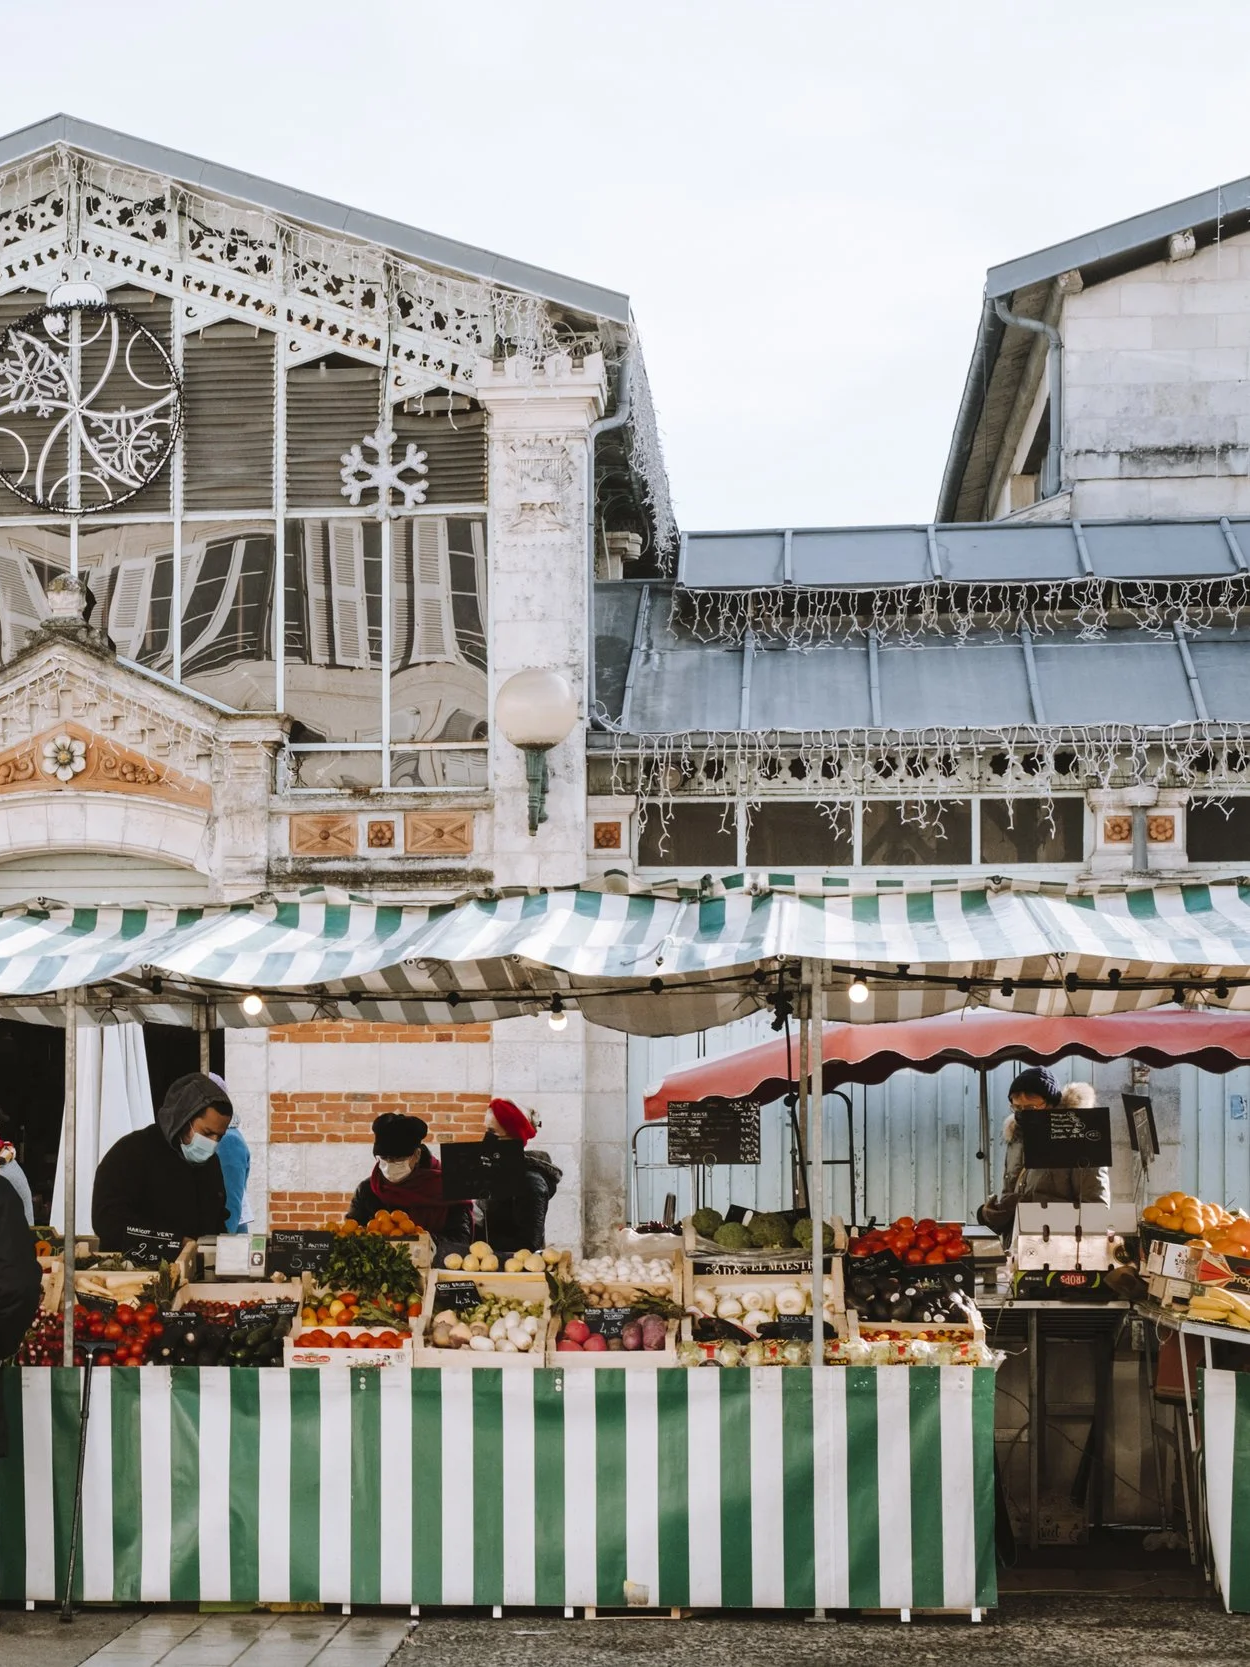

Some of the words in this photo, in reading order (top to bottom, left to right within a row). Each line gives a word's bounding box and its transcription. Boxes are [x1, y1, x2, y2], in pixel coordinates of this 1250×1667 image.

[127, 1226, 151, 1235] HARICOT
[275, 1233, 304, 1242] TOMATE
[768, 1261, 814, 1271] MAESTR
[1060, 1275, 1086, 1284] TROPS
